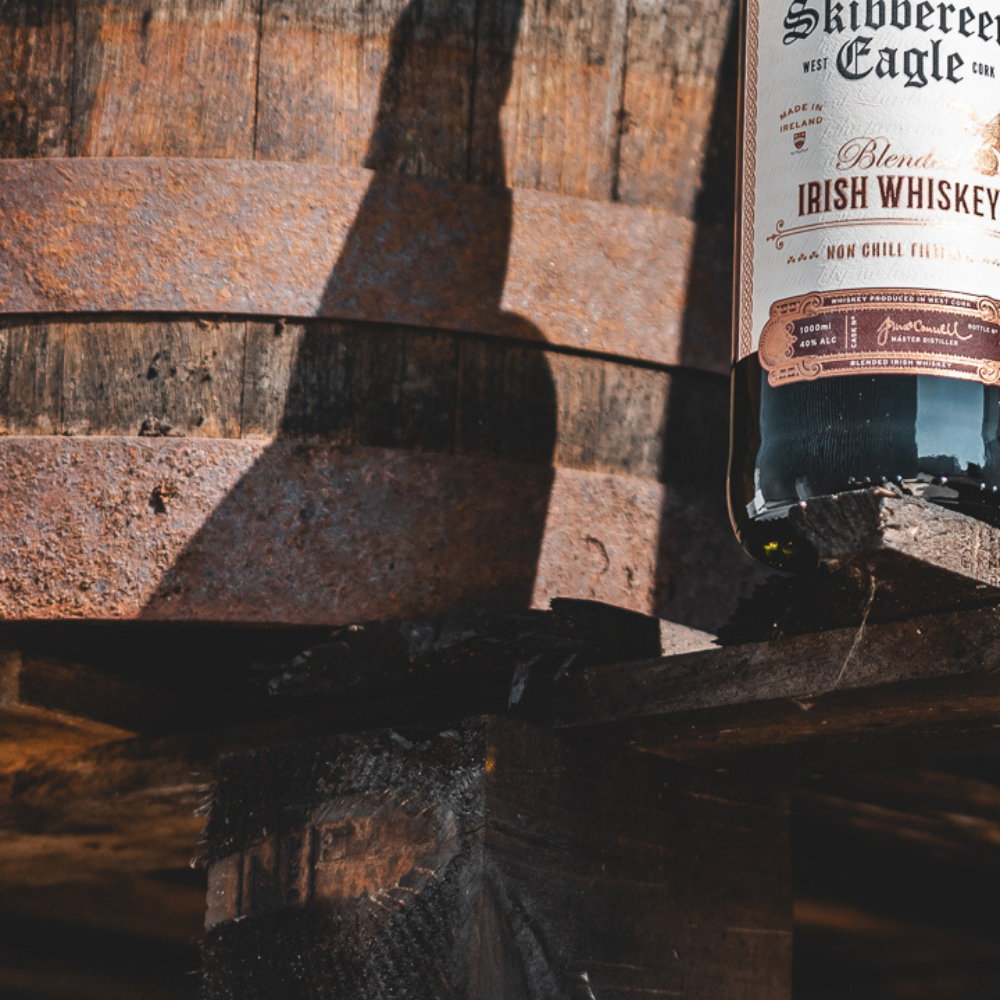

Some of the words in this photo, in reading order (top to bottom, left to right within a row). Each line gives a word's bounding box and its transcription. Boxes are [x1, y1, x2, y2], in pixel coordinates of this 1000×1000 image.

[802, 57, 829, 74] WEST
[835, 35, 965, 89] Eagle
[971, 61, 996, 79] CORK
[779, 103, 808, 121] MADE
[810, 103, 823, 112] IN
[779, 116, 823, 133] IRELAND
[797, 175, 869, 218] IRISH
[876, 174, 1000, 221] WHISKEY
[826, 243, 856, 261] NON
[831, 296, 867, 304] WHISKEY
[916, 295, 926, 303] IN
[928, 297, 949, 305] WEST
[799, 322, 832, 334] 1000ml
[967, 322, 990, 334] BOTTLE
[799, 339, 818, 348] 40%
[819, 335, 838, 346] ALC
[922, 336, 959, 347] DISTILLER
[849, 359, 888, 367] BLENDED
[890, 359, 913, 367] IRISH
[915, 360, 952, 369] WHISKEY
